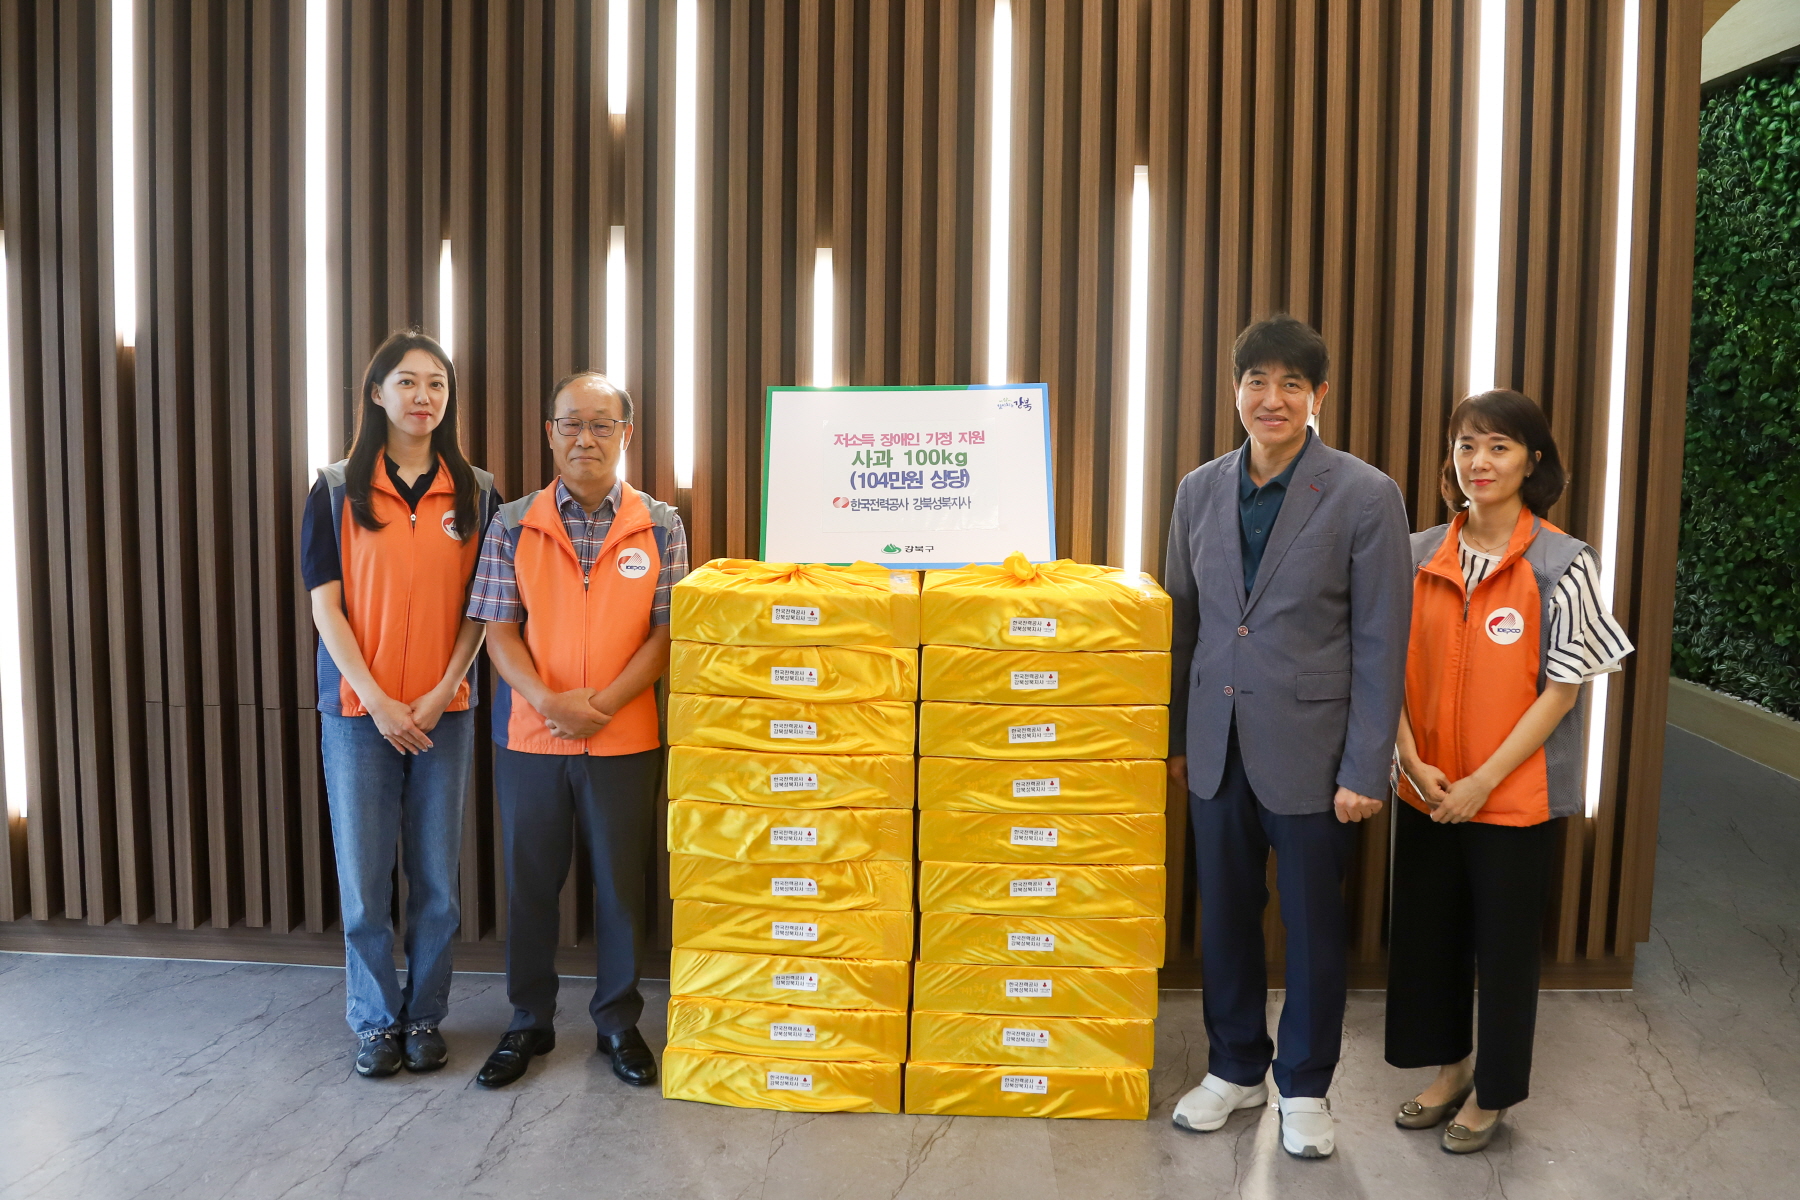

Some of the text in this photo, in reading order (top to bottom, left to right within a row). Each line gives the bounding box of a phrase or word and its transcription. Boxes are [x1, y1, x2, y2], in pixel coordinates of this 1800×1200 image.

[833, 430, 986, 448] 저소득 장애인 가정 지원
[851, 449, 969, 469] 사과 100kg
[850, 468, 971, 490] (104만원 상당)
[850, 496, 972, 512] 한국전력공사 강북성북지사
[904, 545, 935, 554] 강북구
